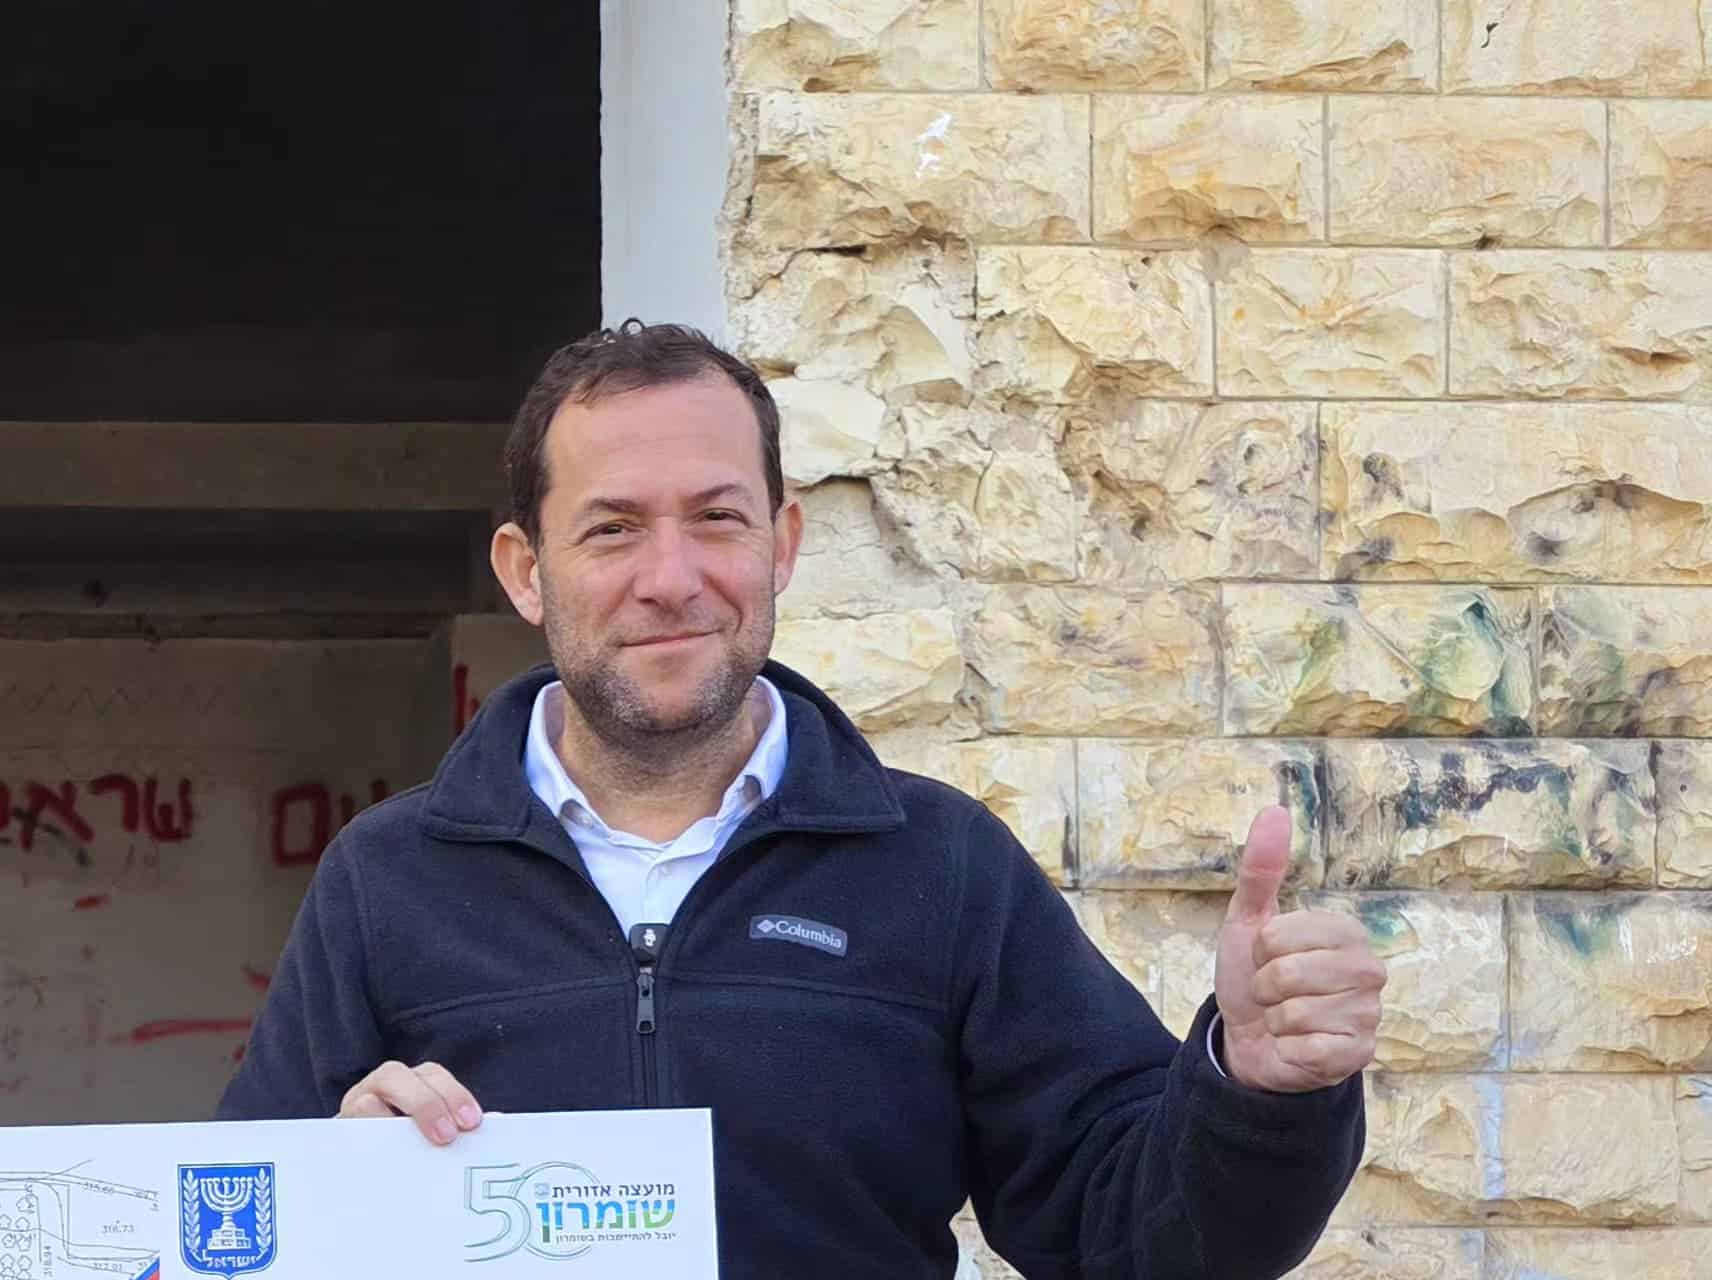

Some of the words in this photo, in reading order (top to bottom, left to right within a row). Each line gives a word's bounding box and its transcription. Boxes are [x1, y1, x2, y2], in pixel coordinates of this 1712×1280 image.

[775, 920, 842, 948] Columbia
[552, 1185, 611, 1199] אזורית
[618, 1183, 675, 1198] מועצה
[536, 1199, 675, 1243] שומרון
[202, 1248, 256, 1268] ישראל
